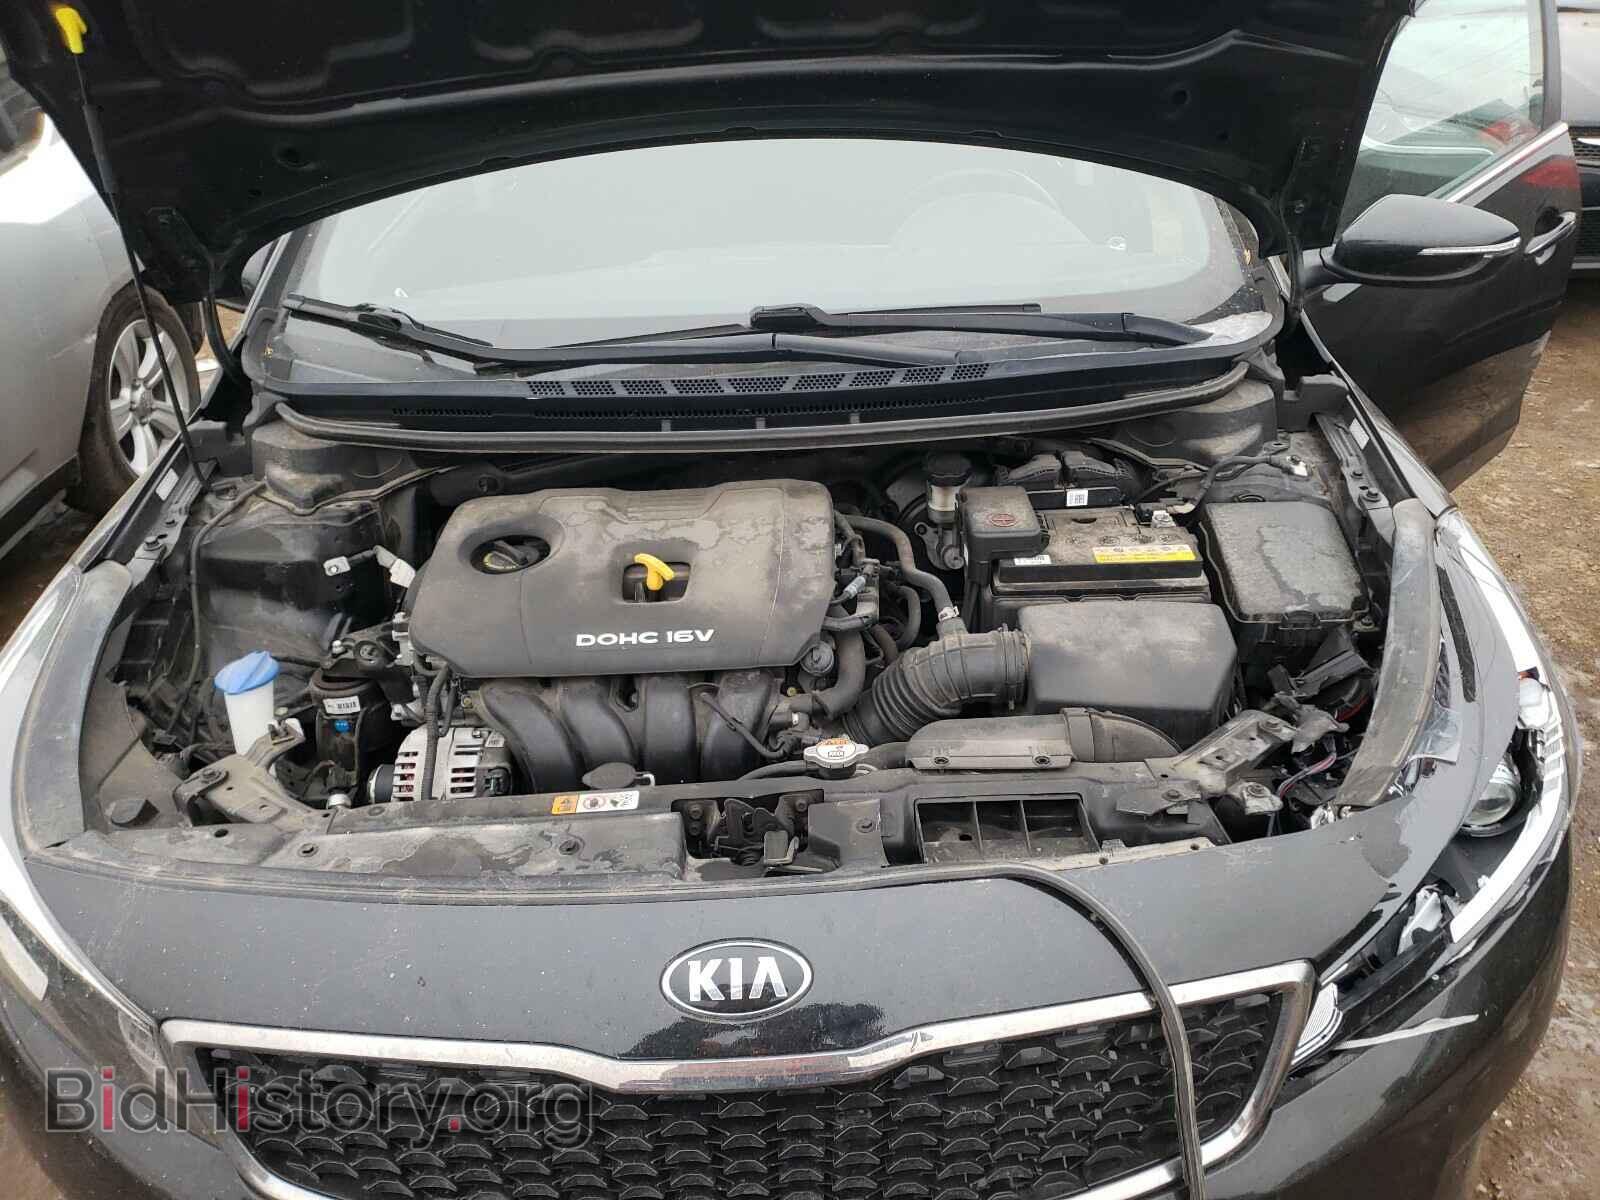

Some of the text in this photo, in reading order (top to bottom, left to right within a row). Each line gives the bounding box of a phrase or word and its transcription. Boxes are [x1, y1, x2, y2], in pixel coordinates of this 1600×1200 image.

[575, 629, 715, 647] DOHC 16V
[687, 956, 788, 1002] KIA
